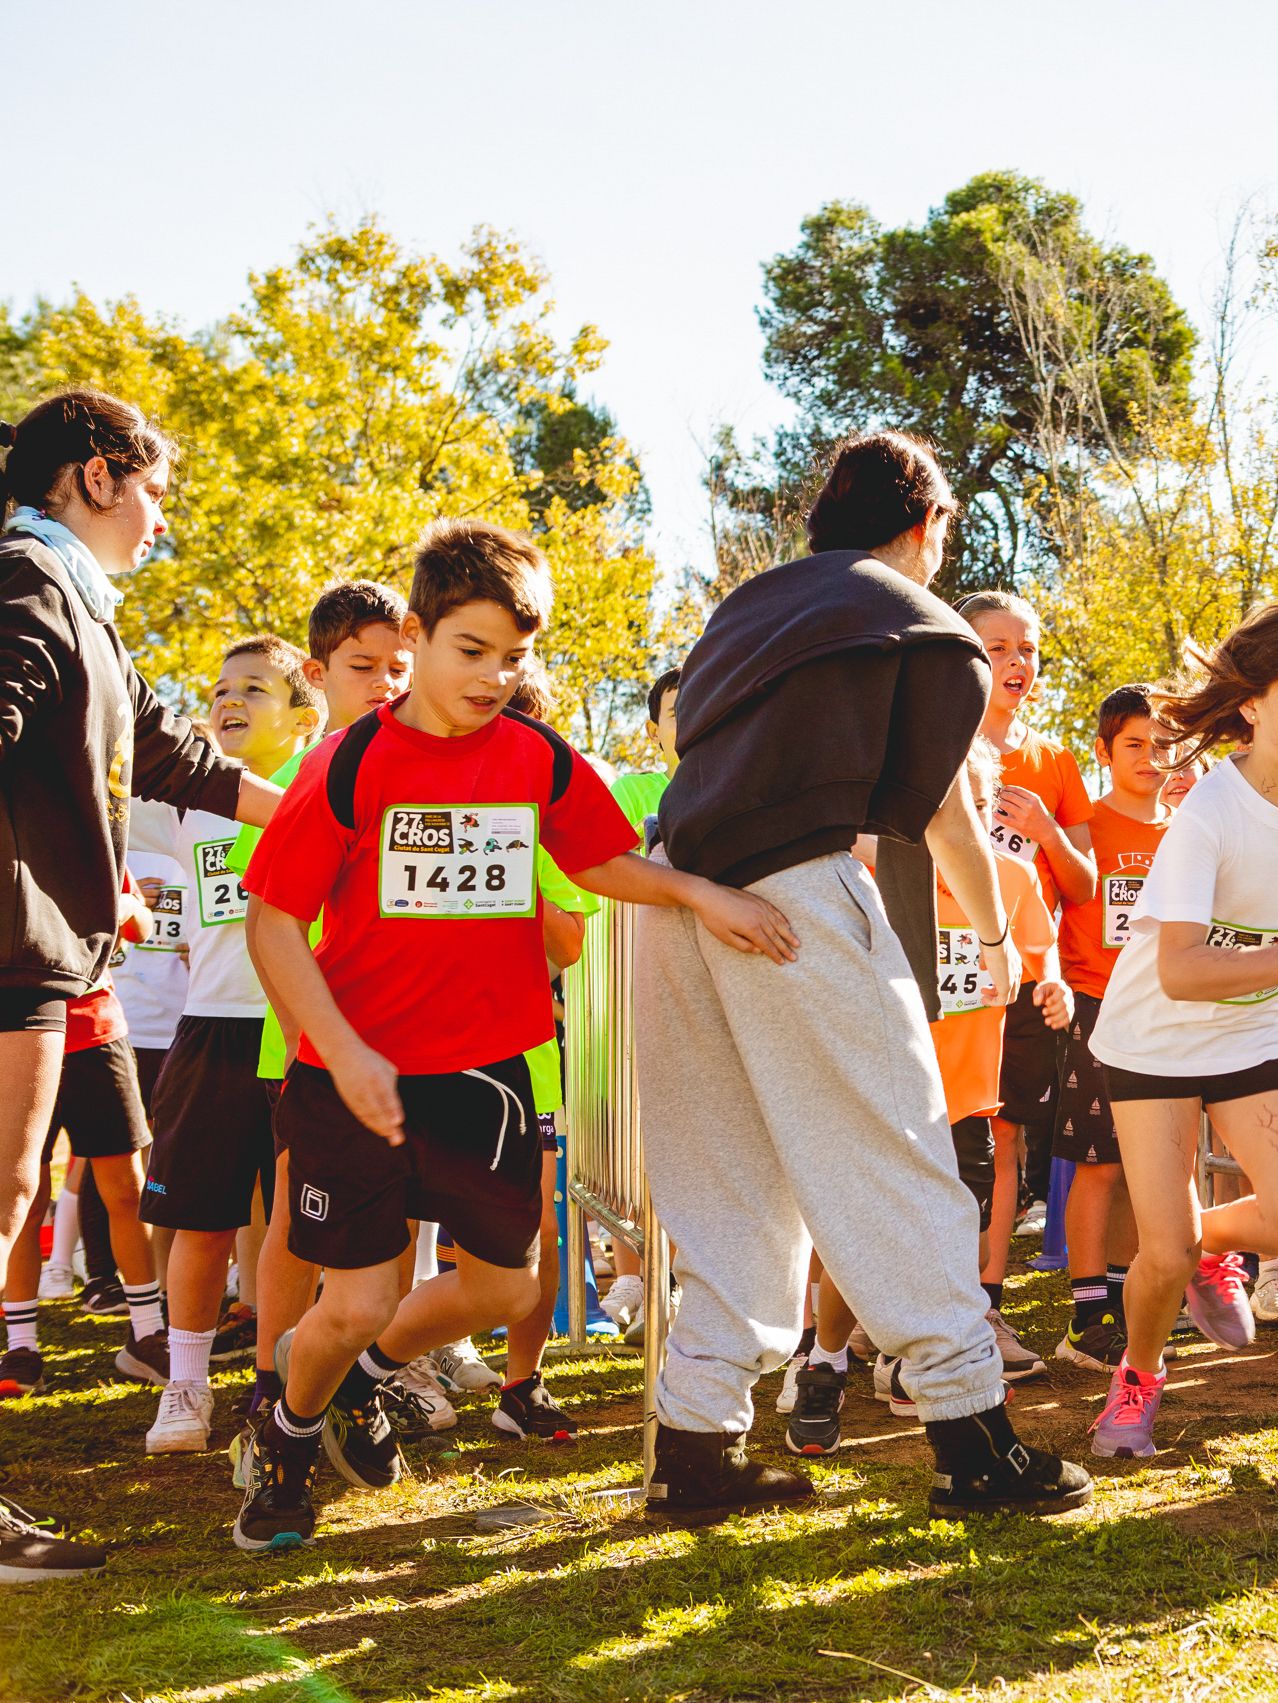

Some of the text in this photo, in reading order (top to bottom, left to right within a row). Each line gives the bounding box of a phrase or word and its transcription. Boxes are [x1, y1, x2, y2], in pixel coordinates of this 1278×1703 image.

[394, 828, 450, 846] CROS
[404, 864, 506, 892] 1428
[940, 973, 978, 995] 45
